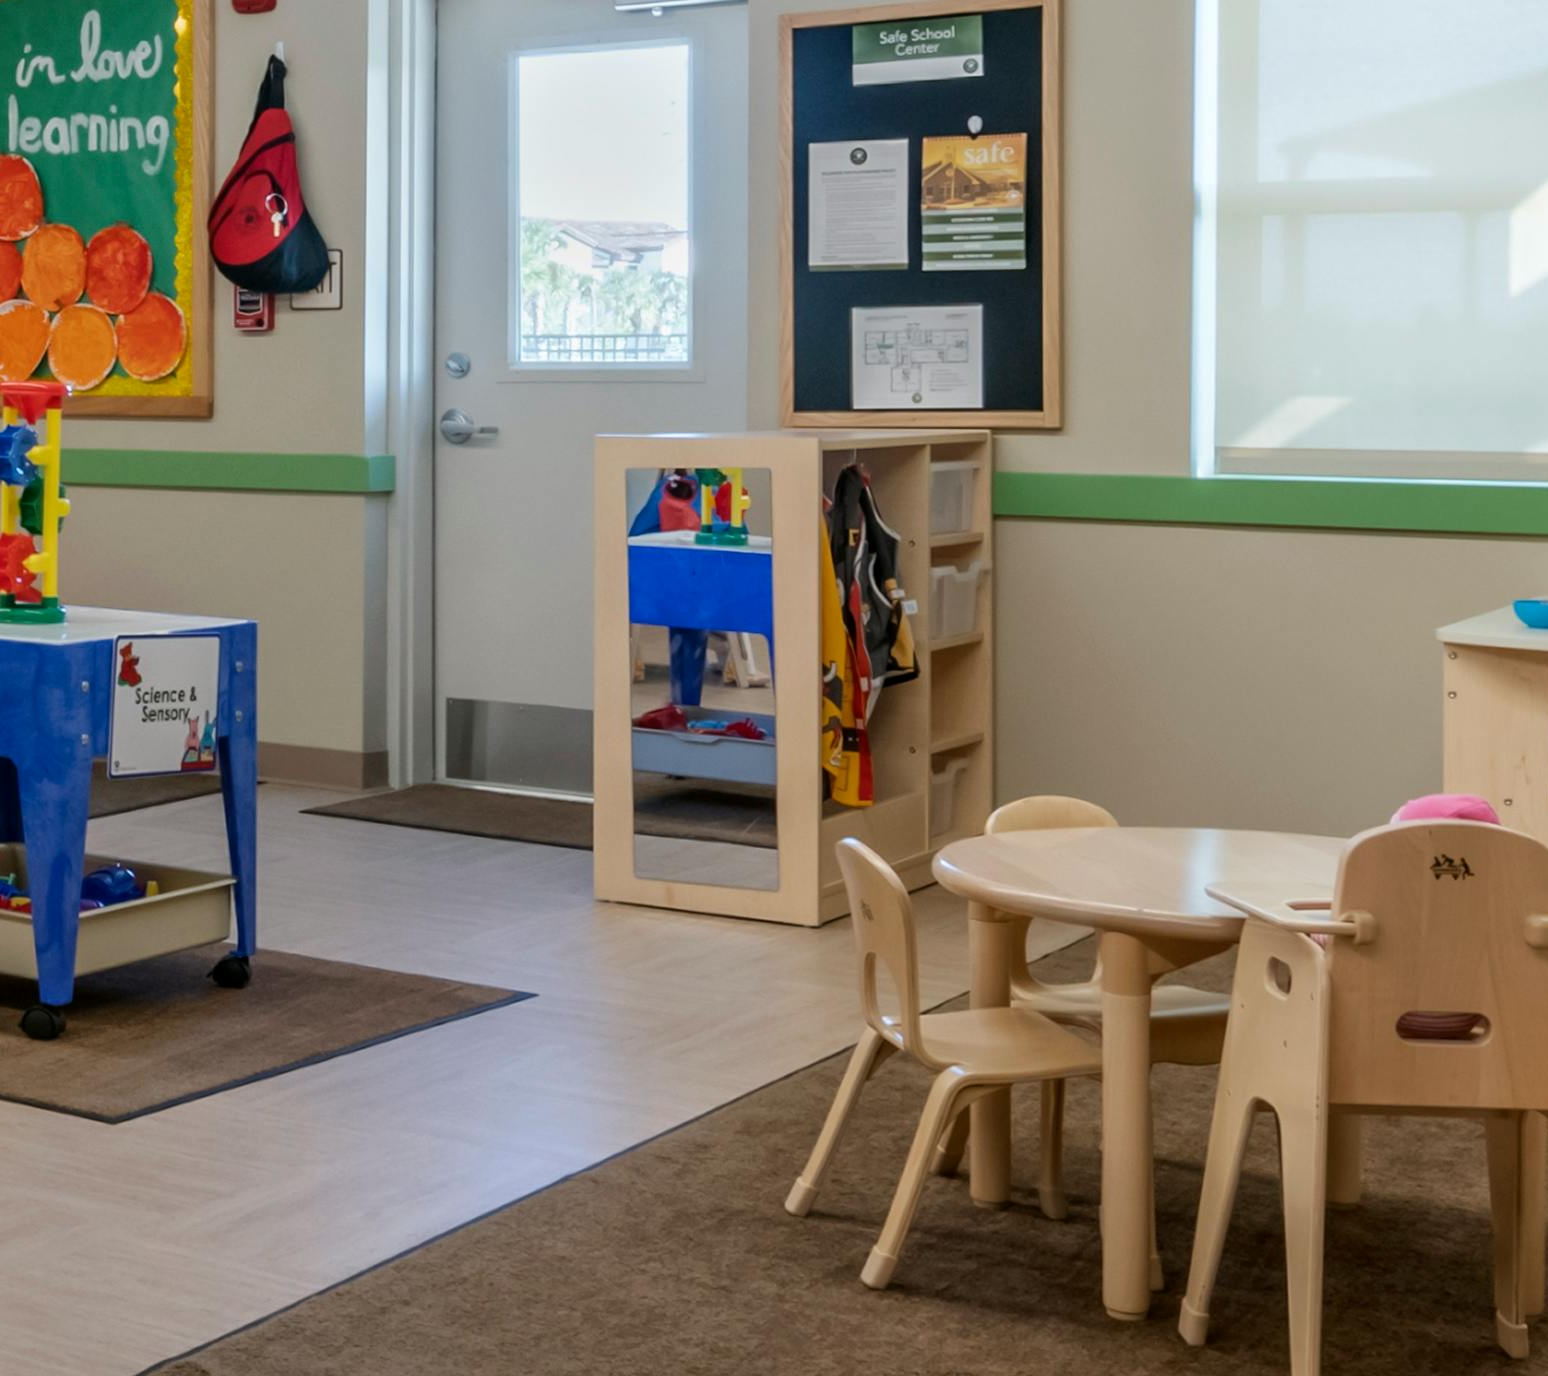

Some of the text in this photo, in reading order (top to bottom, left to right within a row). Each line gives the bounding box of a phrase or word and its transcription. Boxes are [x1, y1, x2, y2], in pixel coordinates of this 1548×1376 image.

[879, 25, 956, 45] Safe School
[15, 42, 65, 87] in
[71, 9, 163, 83] love
[895, 43, 941, 56] Center
[7, 93, 170, 176] learning
[964, 140, 1015, 164] safe
[134, 685, 198, 705] Science &
[141, 705, 191, 724] Sensory
